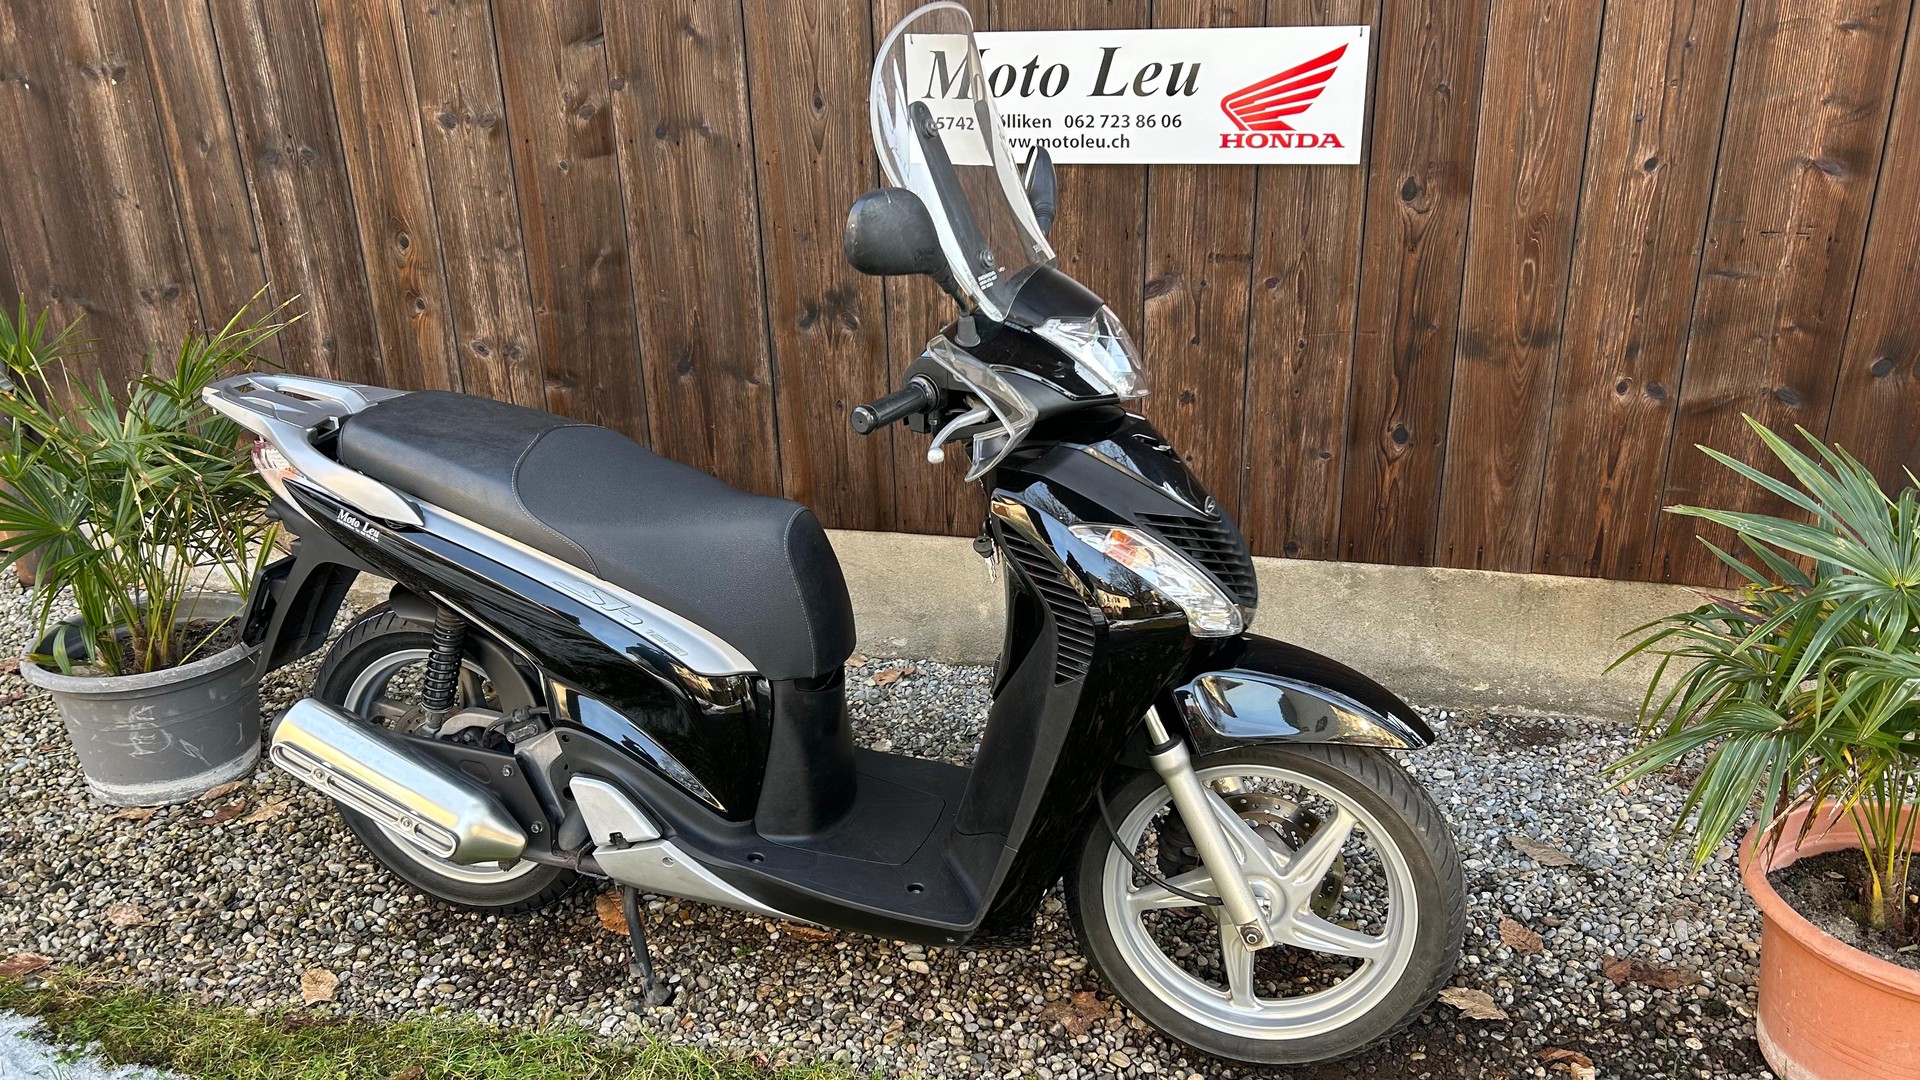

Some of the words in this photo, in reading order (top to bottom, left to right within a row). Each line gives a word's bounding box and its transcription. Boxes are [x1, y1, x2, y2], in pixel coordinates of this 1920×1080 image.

[921, 48, 1070, 99] Moto
[1086, 46, 1202, 97] Leu
[936, 116, 975, 131] 5742
[1000, 113, 1052, 129] lliken
[1064, 114, 1095, 129] 062
[1100, 114, 1131, 129] 723
[1135, 114, 1157, 129] 86
[1161, 114, 1182, 129] 06
[1008, 133, 1131, 149] wwmotoleu.ch
[1219, 132, 1345, 149] HONDA
[337, 508, 361, 528] Moto
[362, 521, 380, 538] Leu
